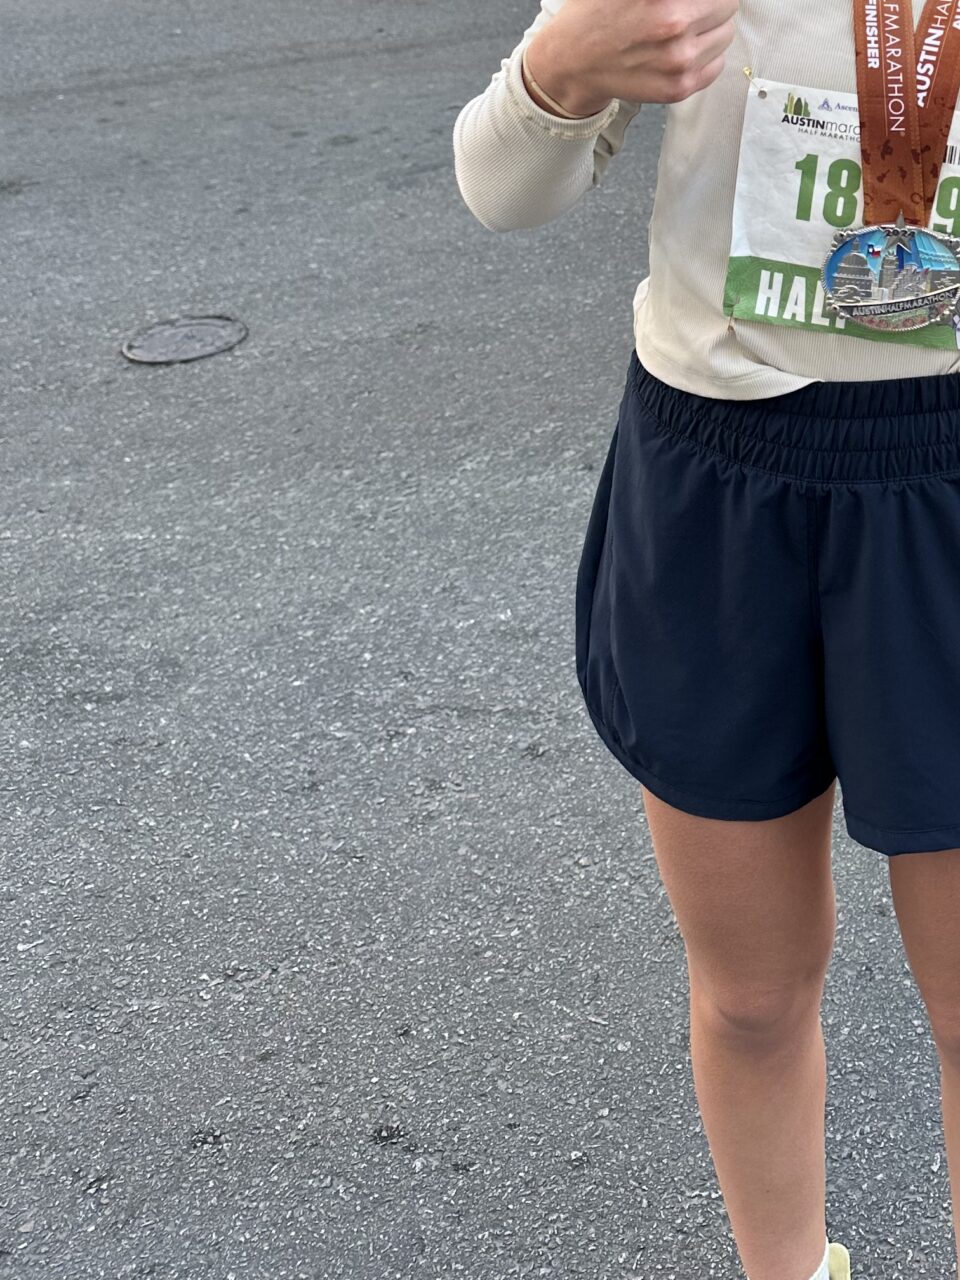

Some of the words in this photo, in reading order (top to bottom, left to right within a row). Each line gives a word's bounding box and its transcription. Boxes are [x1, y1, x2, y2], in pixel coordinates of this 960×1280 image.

[834, 102, 858, 113] Ascen
[798, 127, 818, 136] HALF
[820, 131, 861, 143] MARATHO
[885, 228, 916, 238] 2024
[754, 269, 846, 330] HAL
